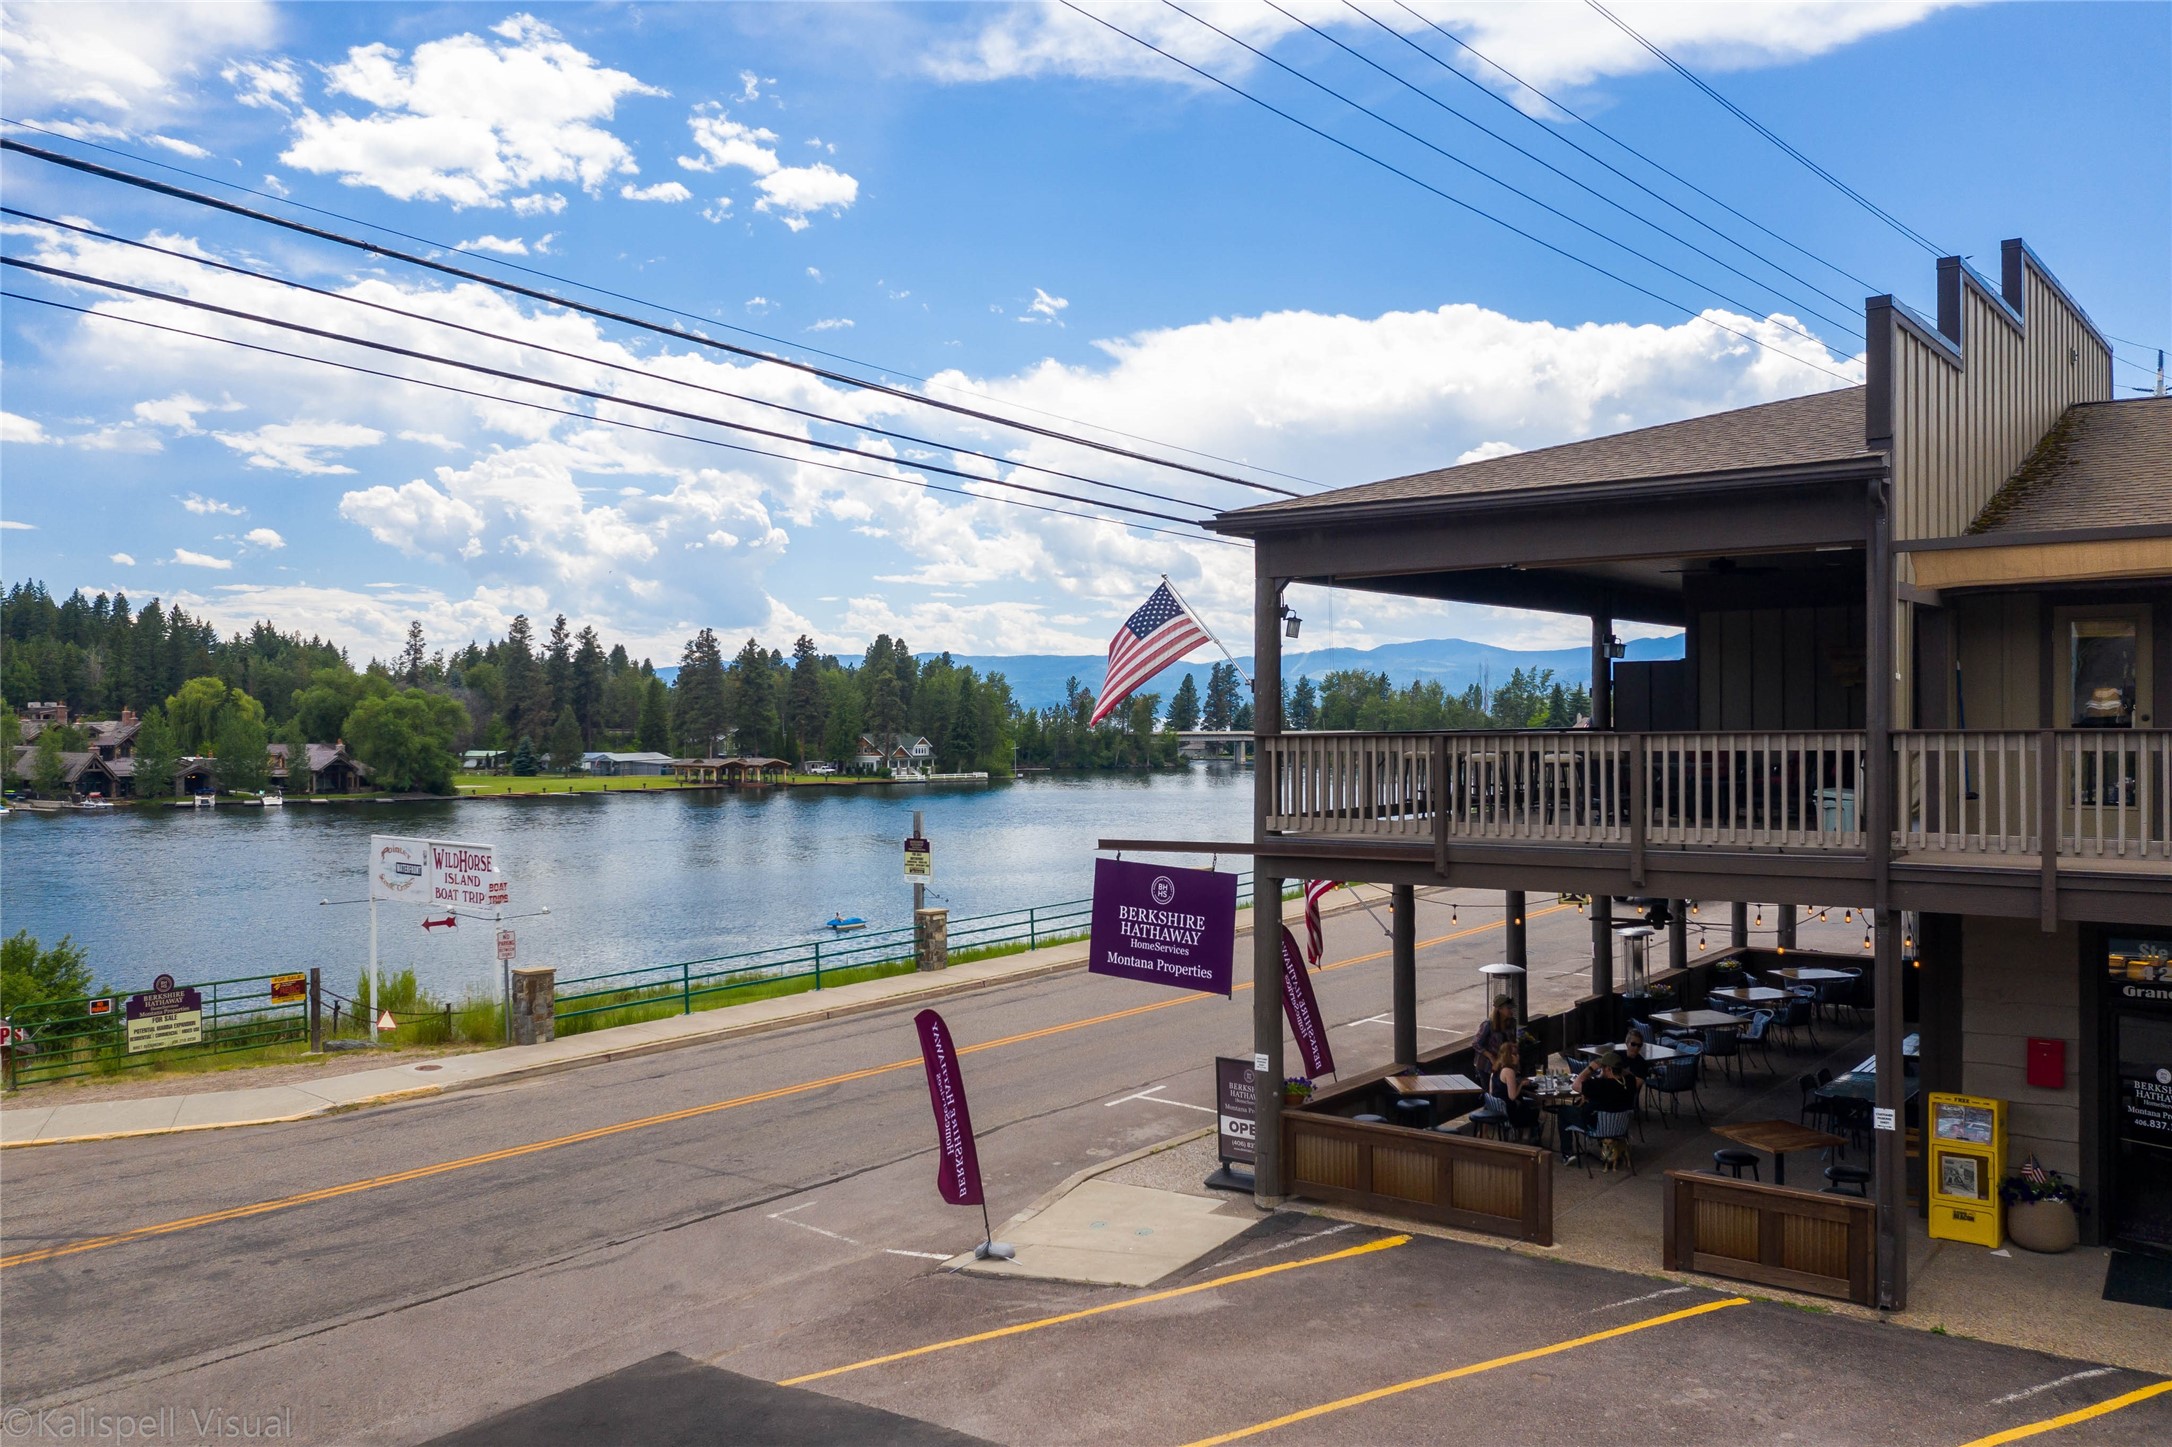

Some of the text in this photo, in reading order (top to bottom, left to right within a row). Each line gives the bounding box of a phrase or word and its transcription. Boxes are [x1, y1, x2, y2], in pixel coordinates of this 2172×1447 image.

[445, 873, 480, 887] ISLAND
[489, 882, 507, 892] BOAT
[435, 887, 485, 904] BOAT TRIP
[1119, 905, 1205, 930] BERKSHIRE
[1120, 921, 1201, 945] HATHAWAY
[1131, 939, 1189, 956] HomeServices
[1107, 951, 1213, 979] Montana Properties
[143, 991, 185, 1001] BERKSHIRE
[145, 997, 184, 1007] HATHAWAY
[163, 1006, 190, 1014] Properties
[152, 1015, 163, 1023] FOR
[2136, 1089, 2172, 1103] HATHA
[1225, 1103, 1247, 1113] Montana
[2128, 1105, 2161, 1118] Montana
[1229, 1120, 1255, 1136] OPE
